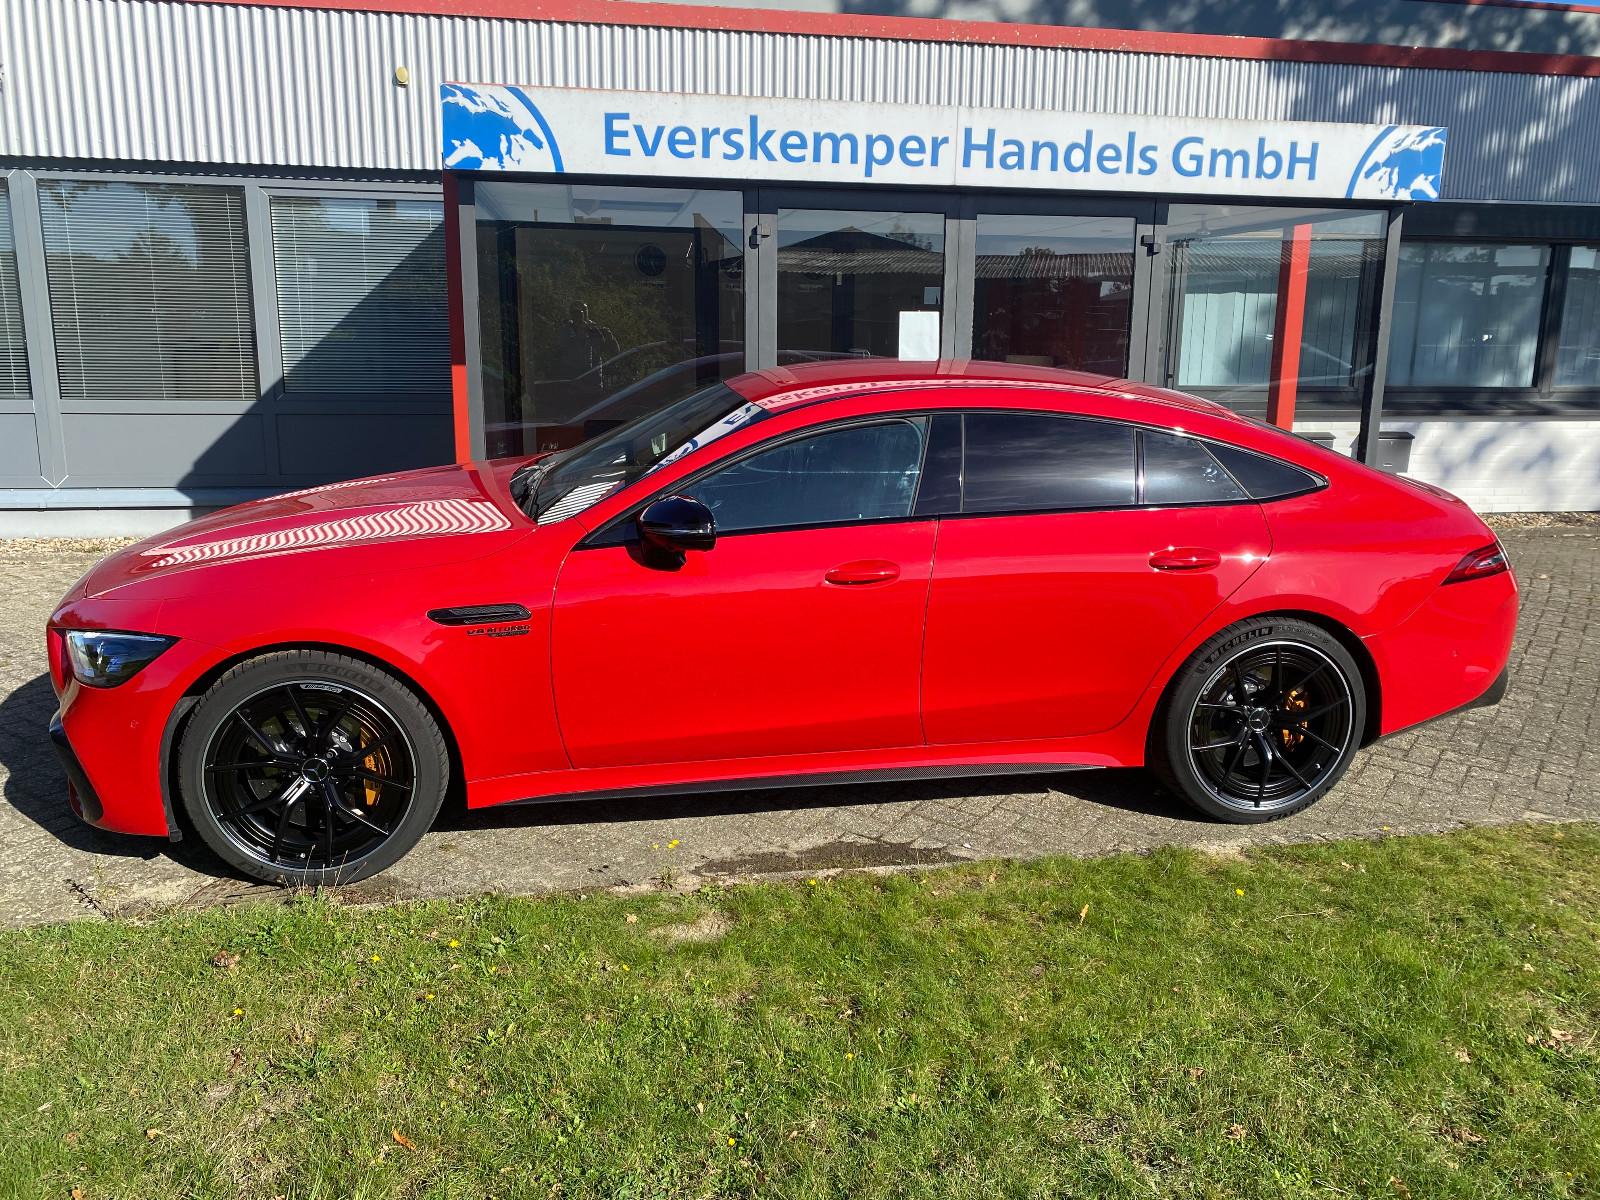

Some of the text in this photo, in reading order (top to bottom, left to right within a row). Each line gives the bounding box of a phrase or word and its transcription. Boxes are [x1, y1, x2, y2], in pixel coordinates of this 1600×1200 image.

[604, 112, 1319, 181] Everskemper Handels GmbH
[1209, 626, 1272, 661] MICHELIN
